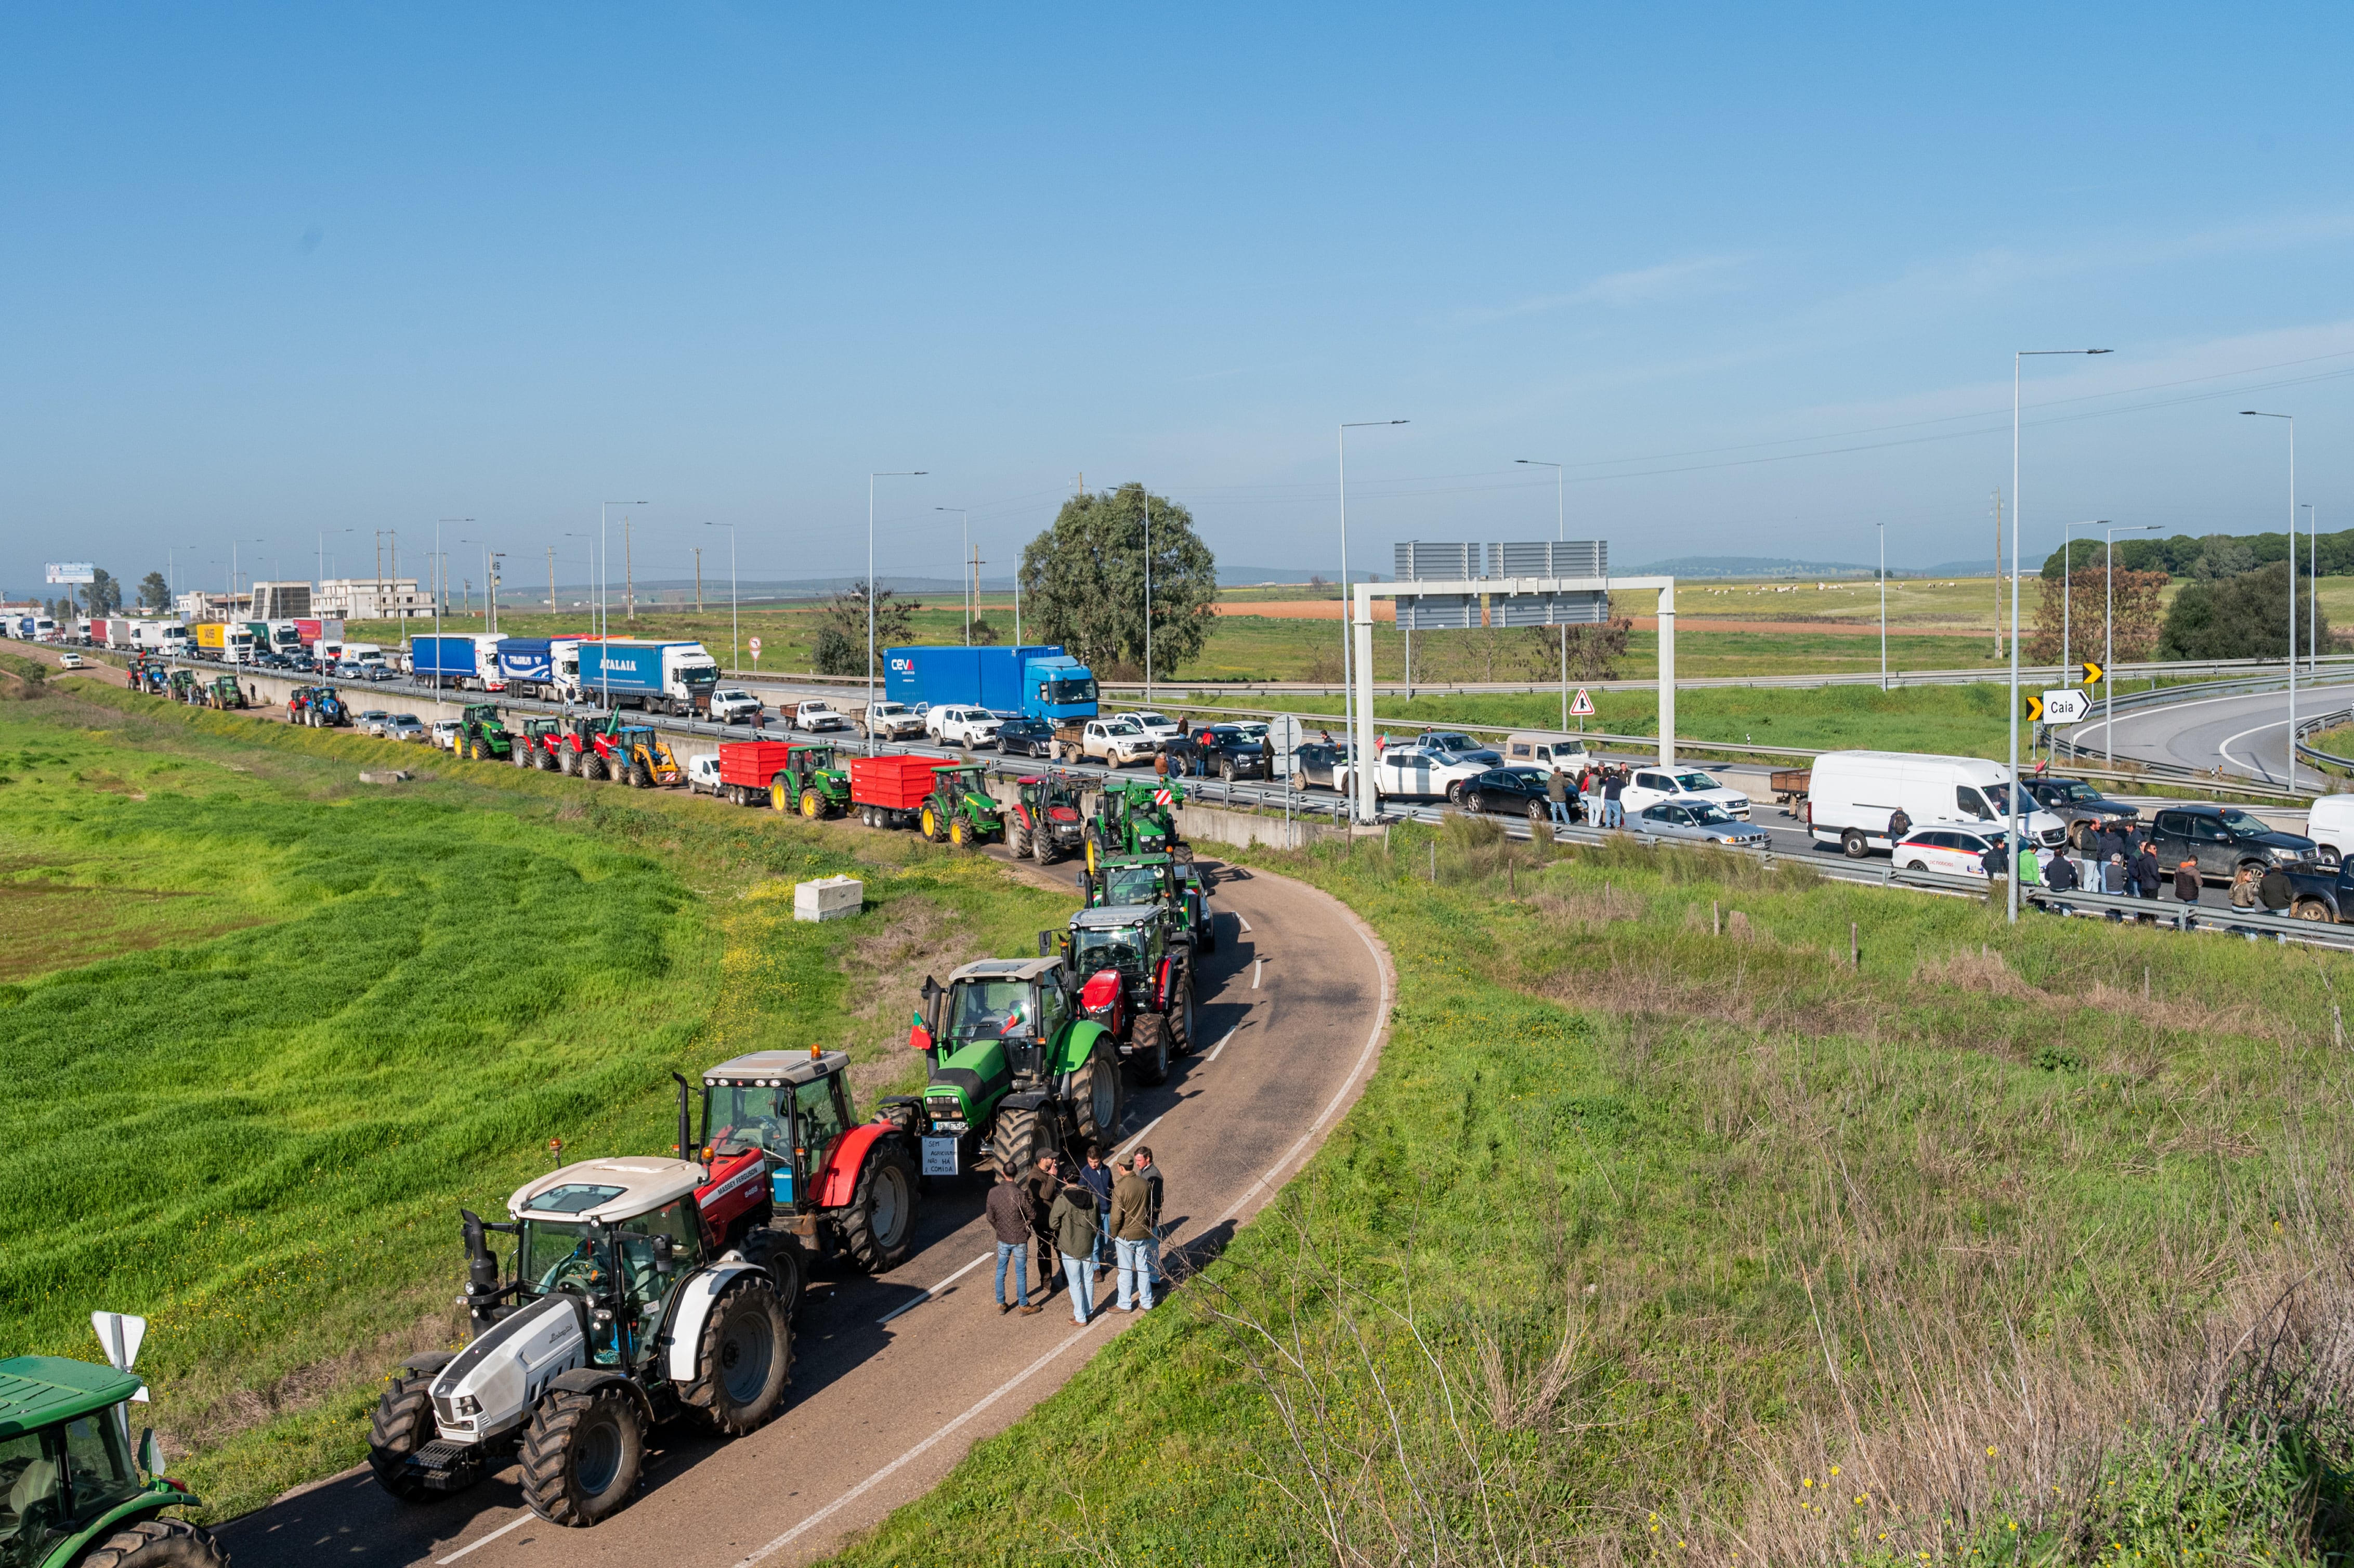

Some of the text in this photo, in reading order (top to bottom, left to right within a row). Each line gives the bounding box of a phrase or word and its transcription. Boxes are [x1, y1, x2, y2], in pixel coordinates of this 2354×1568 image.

[599, 659, 636, 671] ATALAIA
[2051, 700, 2073, 713] Caia
[941, 1157, 951, 1165] HÁ
[717, 1167, 757, 1195] MASSEY FERGUSON
